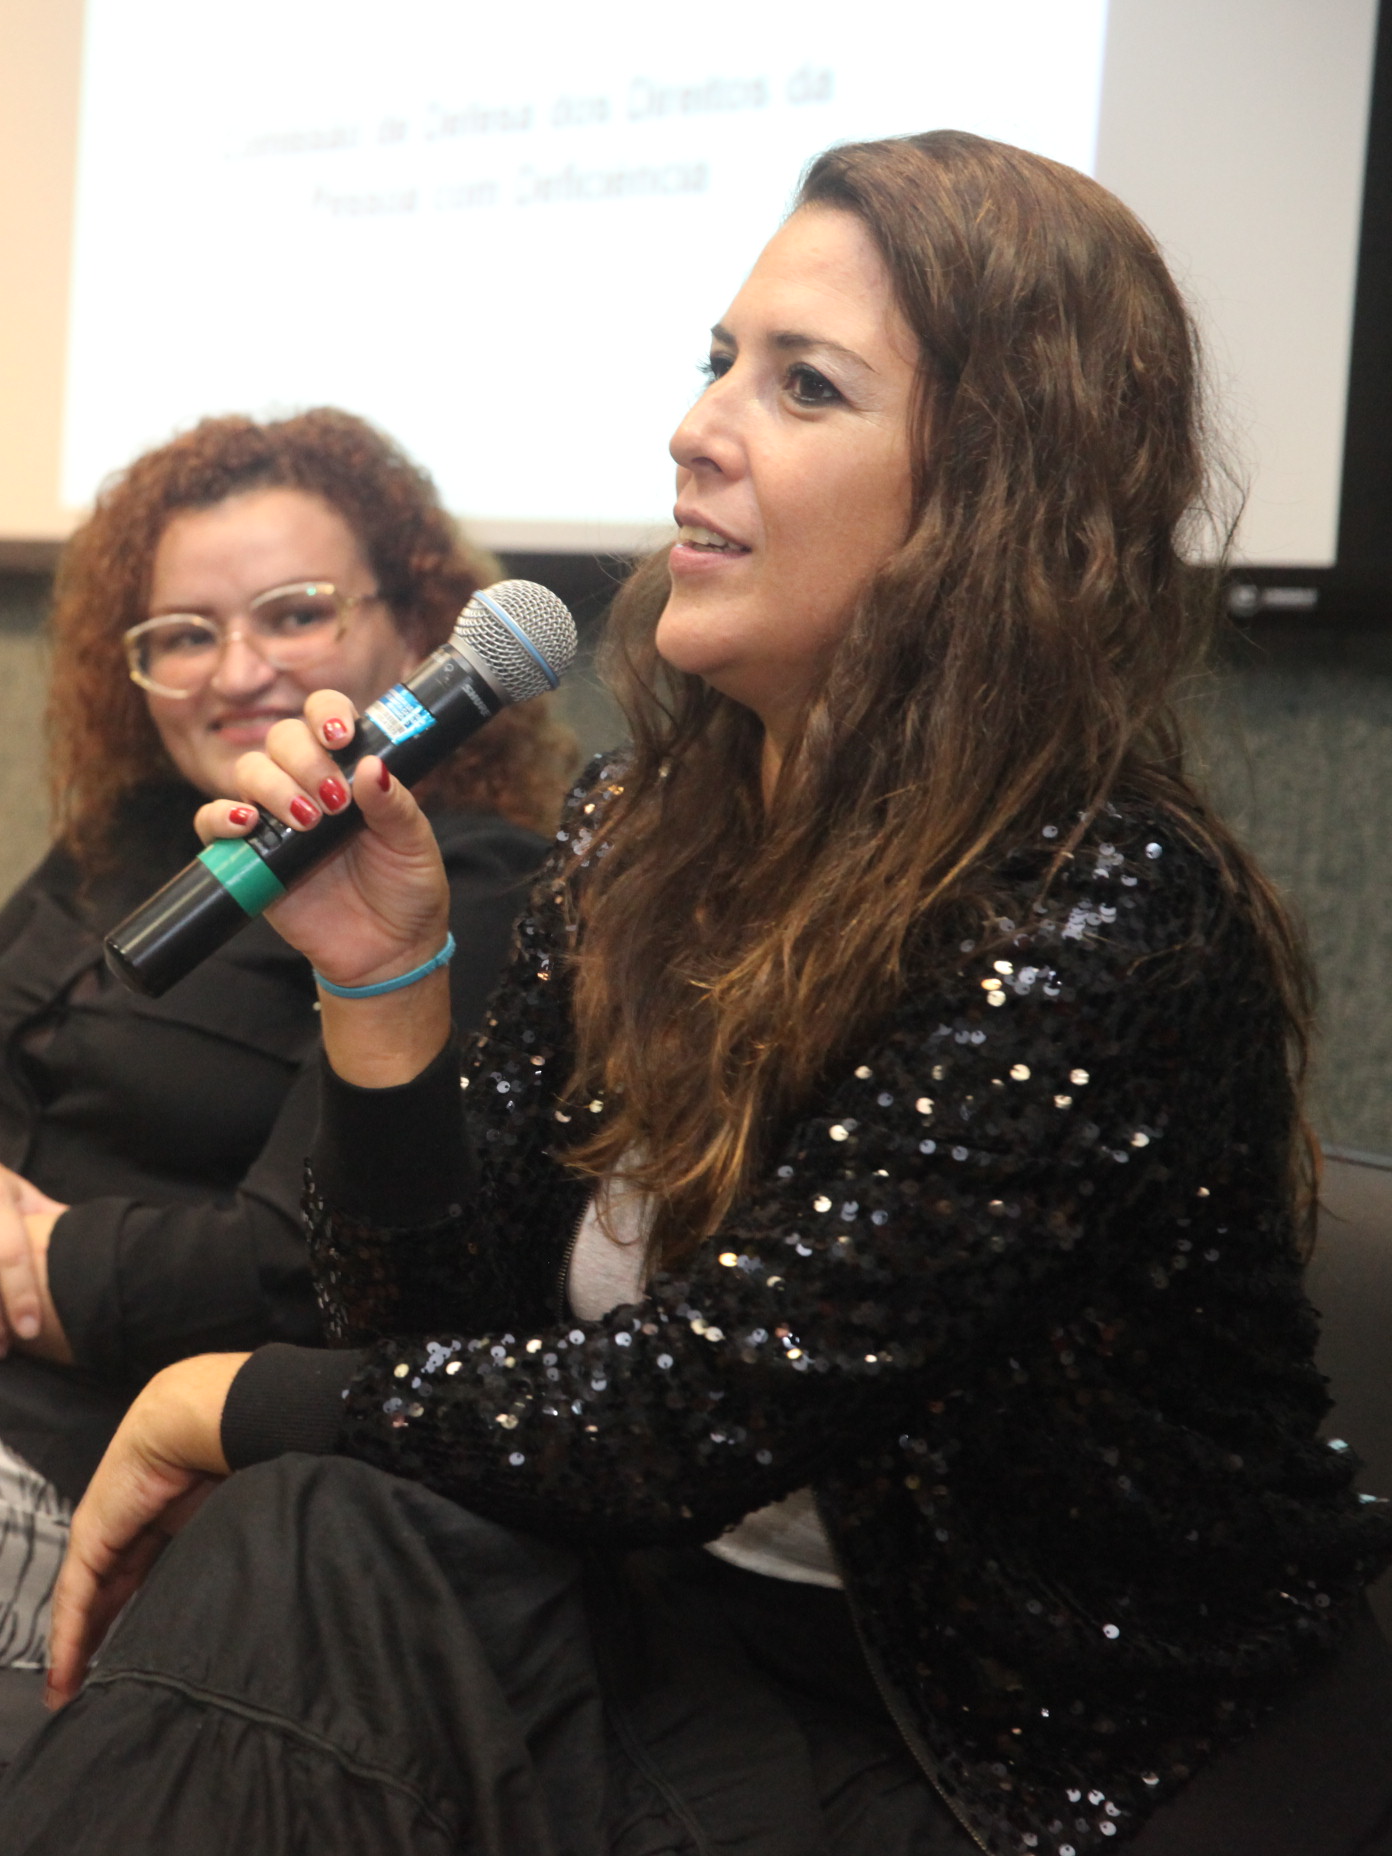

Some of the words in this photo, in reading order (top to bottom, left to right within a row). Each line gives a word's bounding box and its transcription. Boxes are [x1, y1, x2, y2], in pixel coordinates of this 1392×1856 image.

[628, 75, 770, 122] Direitos
[785, 62, 835, 105] da
[462, 684, 490, 717] SHURE
